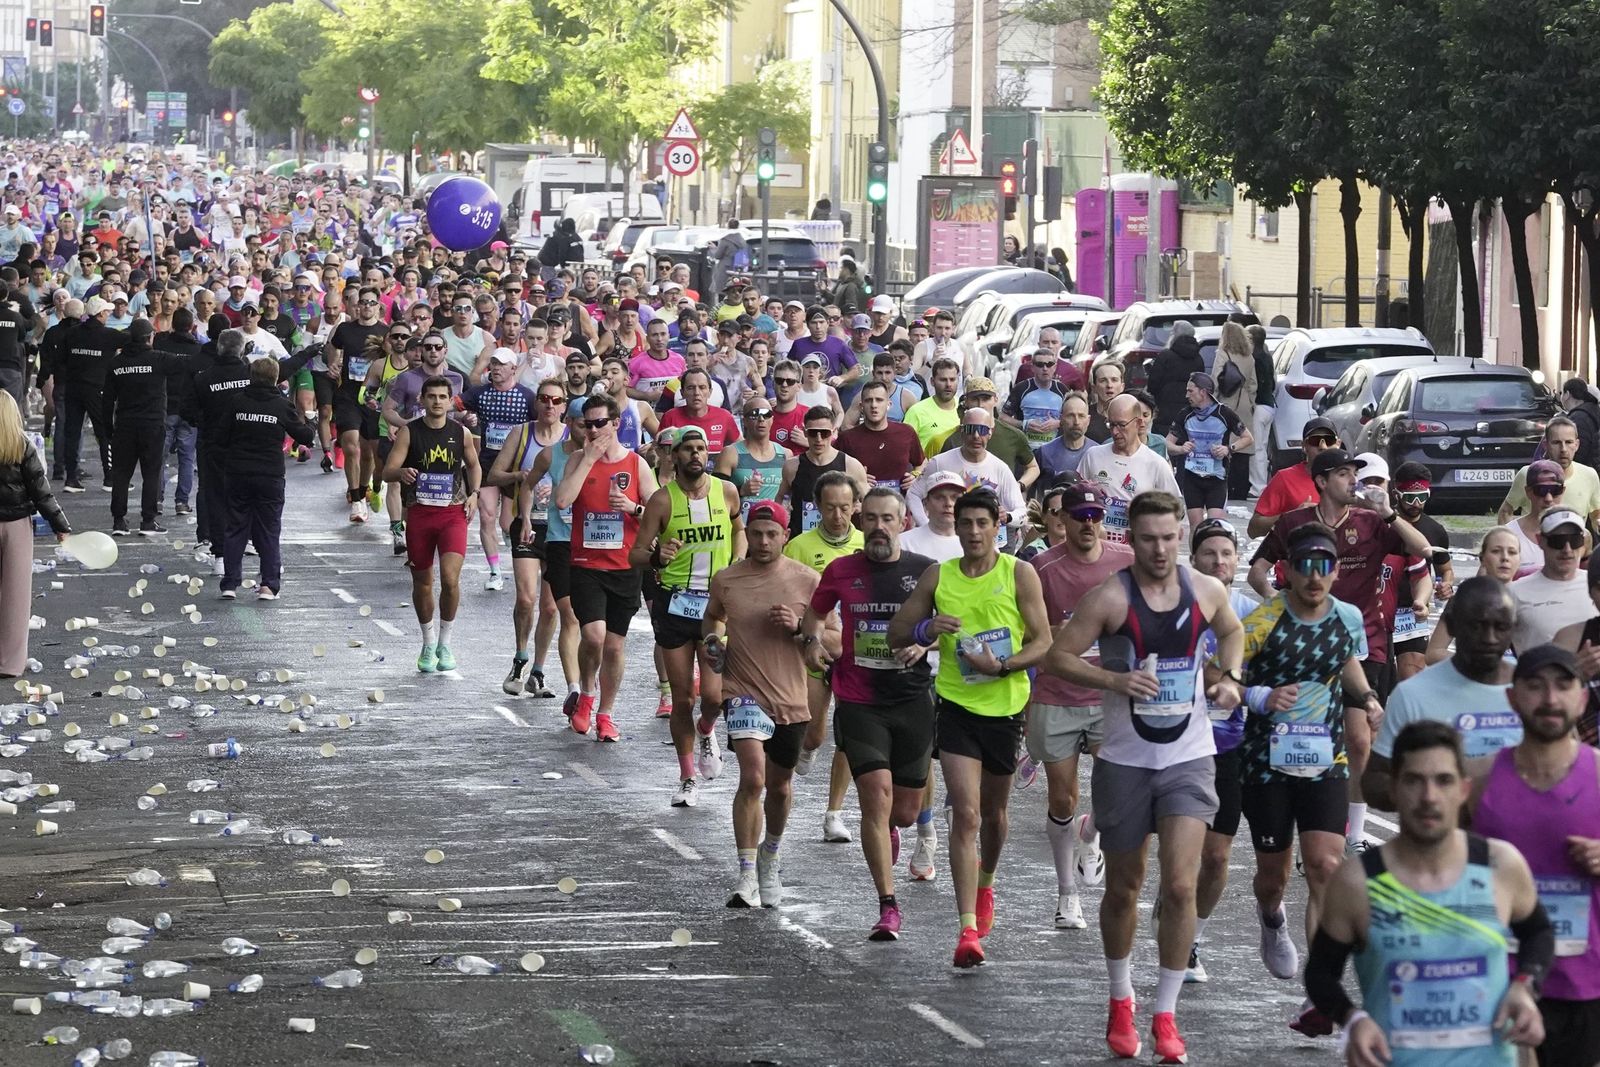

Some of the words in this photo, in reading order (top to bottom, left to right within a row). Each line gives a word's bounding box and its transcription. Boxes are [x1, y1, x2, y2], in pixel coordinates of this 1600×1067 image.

[672, 153, 692, 165] 30
[472, 206, 494, 230] 3:15
[71, 348, 102, 356] VOLUNTEER
[113, 365, 152, 375] VOLUNTEER
[209, 379, 251, 392] VOLUNTEER
[235, 412, 278, 424] VOLUNTEER
[1463, 471, 1489, 480] 4249
[1493, 471, 1513, 480] GBR
[590, 532, 616, 540] HARRY
[683, 607, 700, 617] BCK
[1395, 622, 1417, 633] SAMY
[977, 630, 1005, 642] URICH
[1156, 661, 1189, 670] ZURICH
[727, 719, 749, 729] MON
[751, 719, 775, 733] LAPIN
[1292, 725, 1325, 733] ZURICH
[1285, 752, 1319, 764] DIEGO
[1423, 962, 1478, 978] ZURICH
[1402, 1003, 1480, 1026] NICOLÁS
